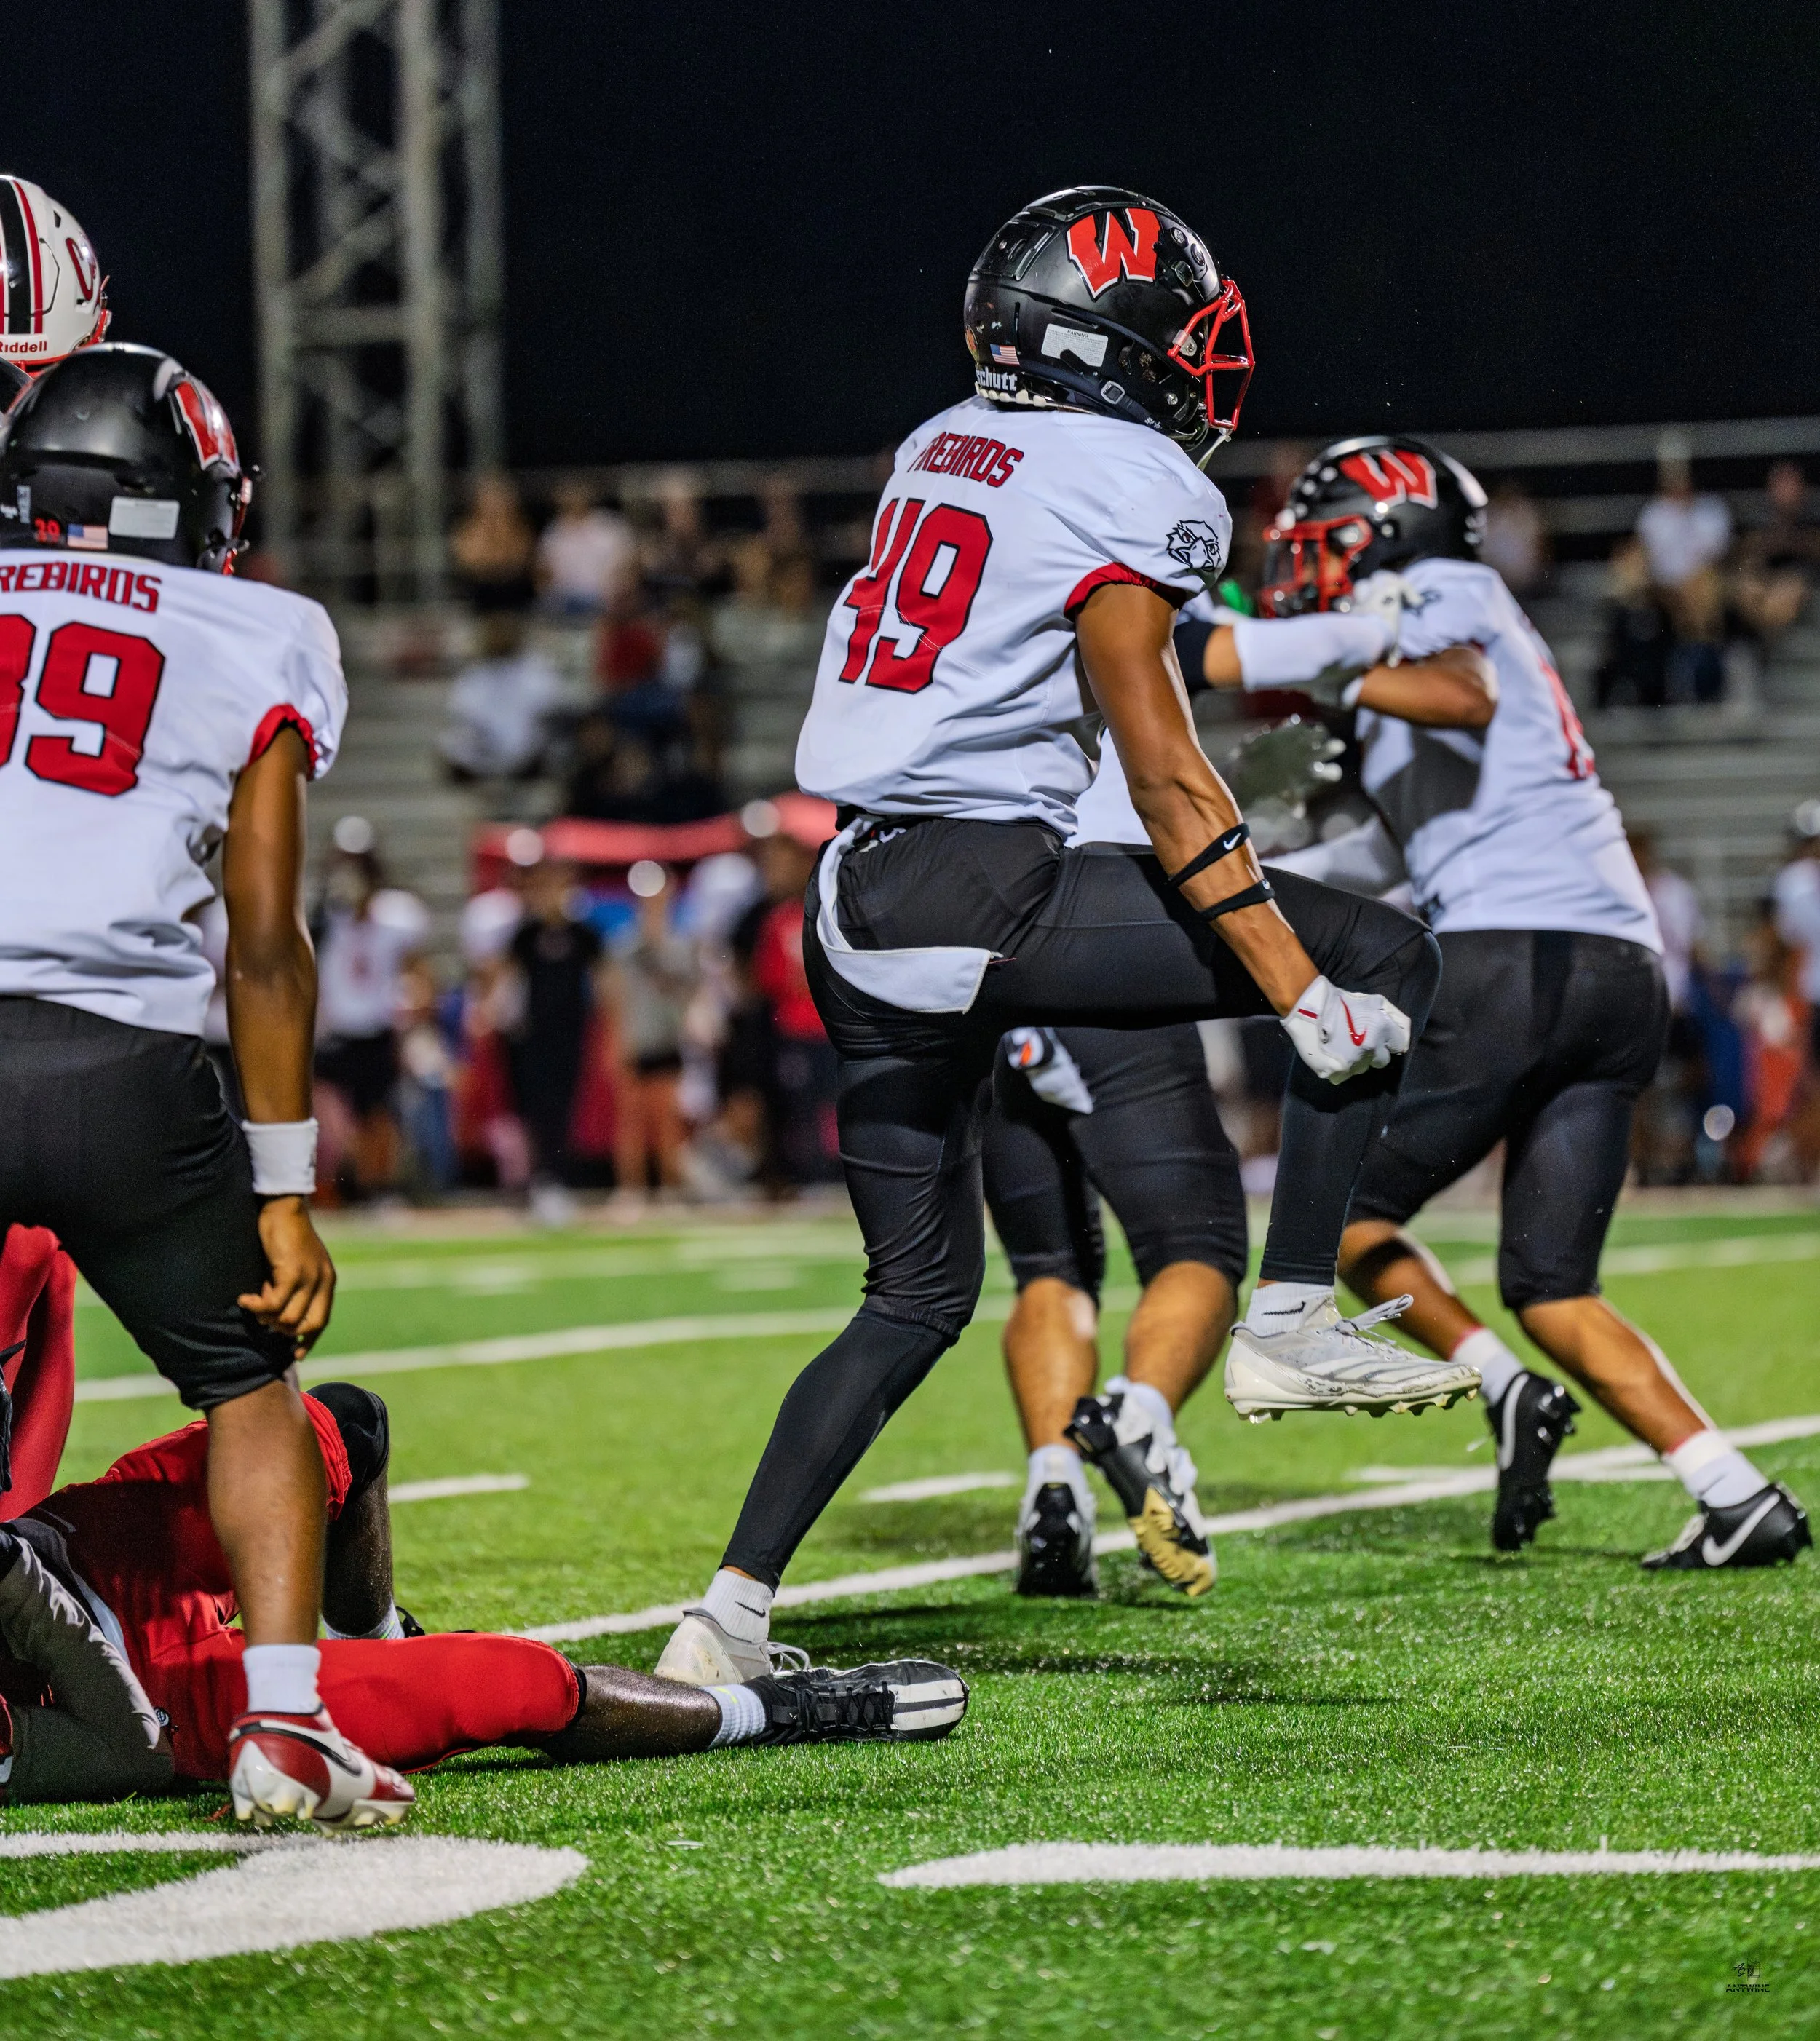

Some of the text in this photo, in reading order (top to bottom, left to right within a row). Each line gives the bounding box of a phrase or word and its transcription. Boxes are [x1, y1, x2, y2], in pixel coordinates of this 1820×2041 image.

[1065, 207, 1160, 300] W
[1066, 329, 1089, 338] WARNING
[907, 432, 1024, 488] REBIRDS
[1340, 449, 1439, 510] W
[838, 497, 994, 695] 49
